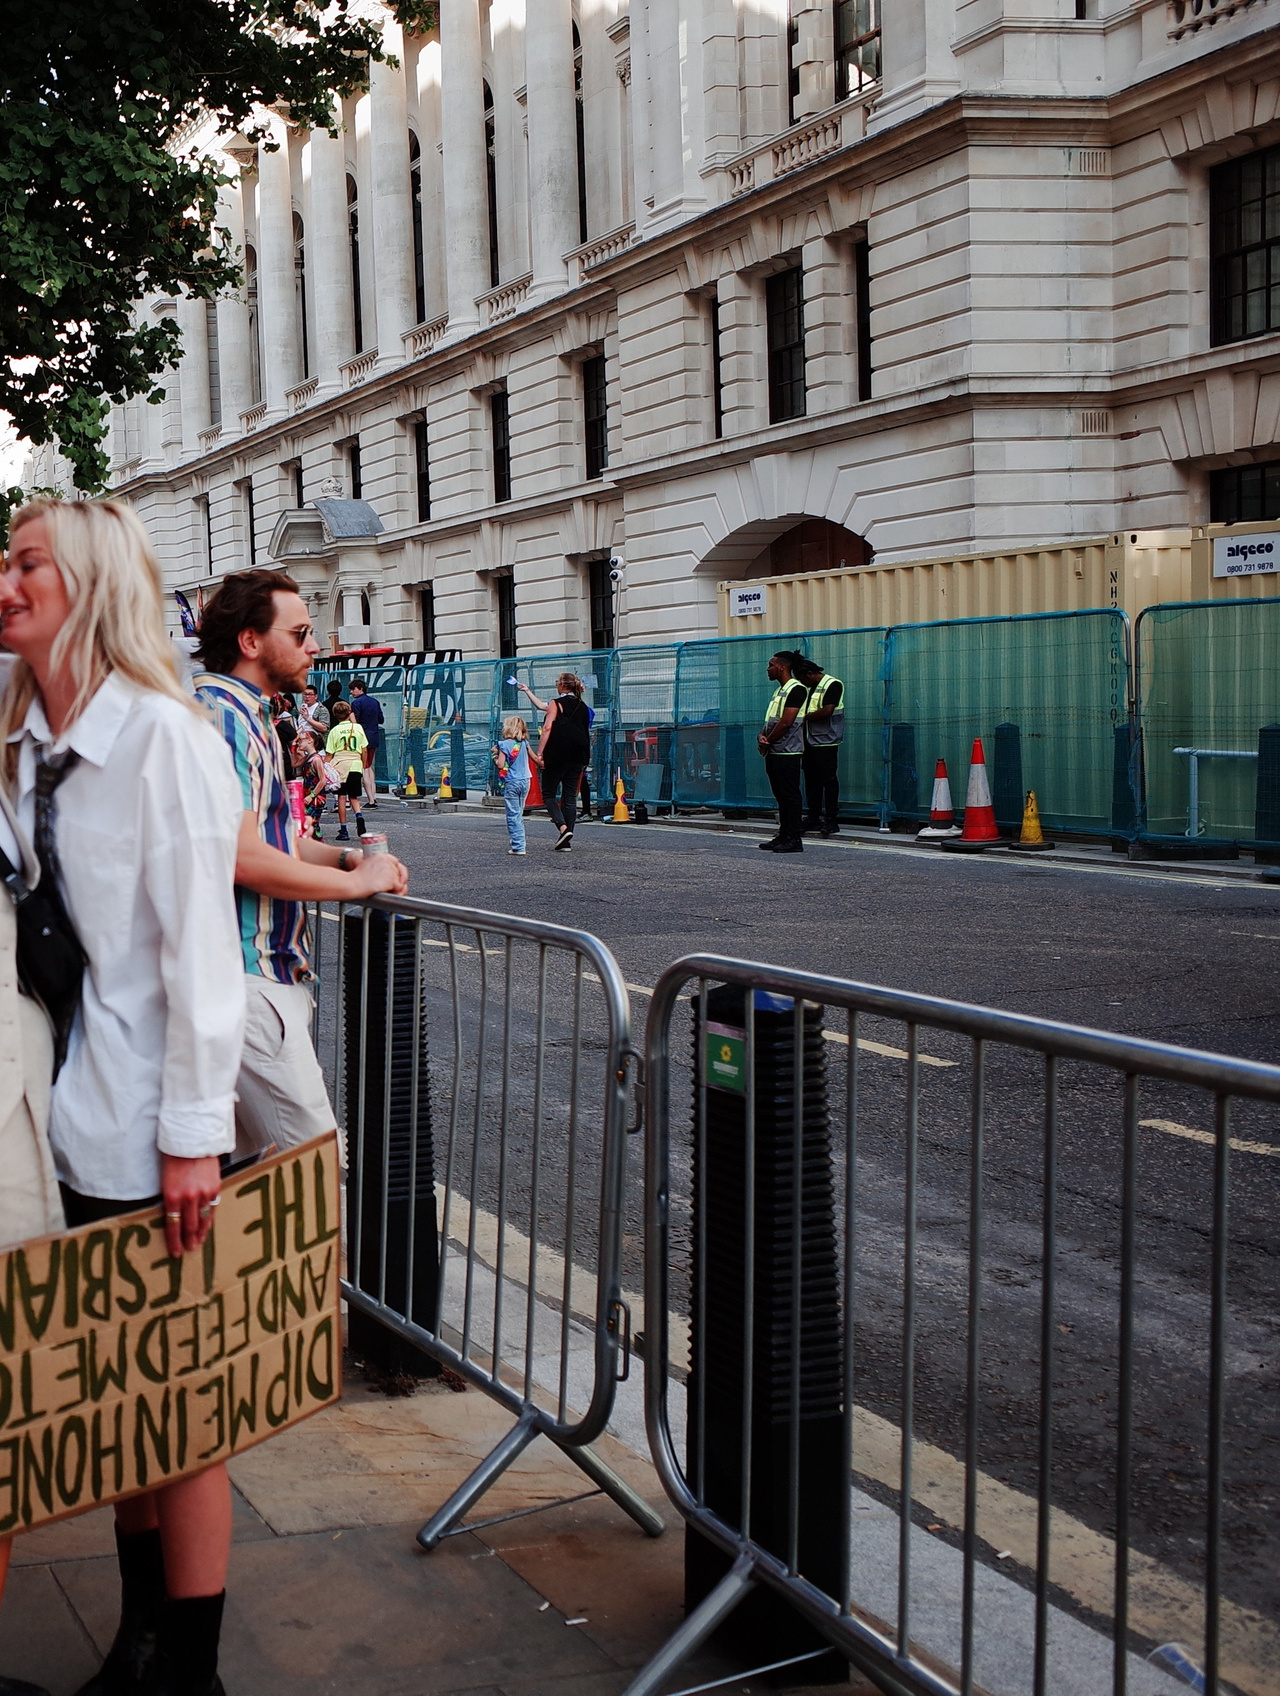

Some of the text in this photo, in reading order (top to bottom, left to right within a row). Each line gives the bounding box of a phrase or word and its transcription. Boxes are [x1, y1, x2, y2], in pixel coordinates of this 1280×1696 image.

[1226, 562, 1274, 574] 0800 731 9878
[1227, 543, 1274, 561] algeco
[340, 736, 357, 751] 10
[236, 1149, 340, 1278] THE
[135, 1278, 252, 1384] FEED
[256, 1246, 333, 1334] AND
[50, 1321, 128, 1415] ME
[197, 1353, 259, 1461] ME
[266, 1315, 334, 1428] DIP
[135, 1387, 188, 1488] IN
